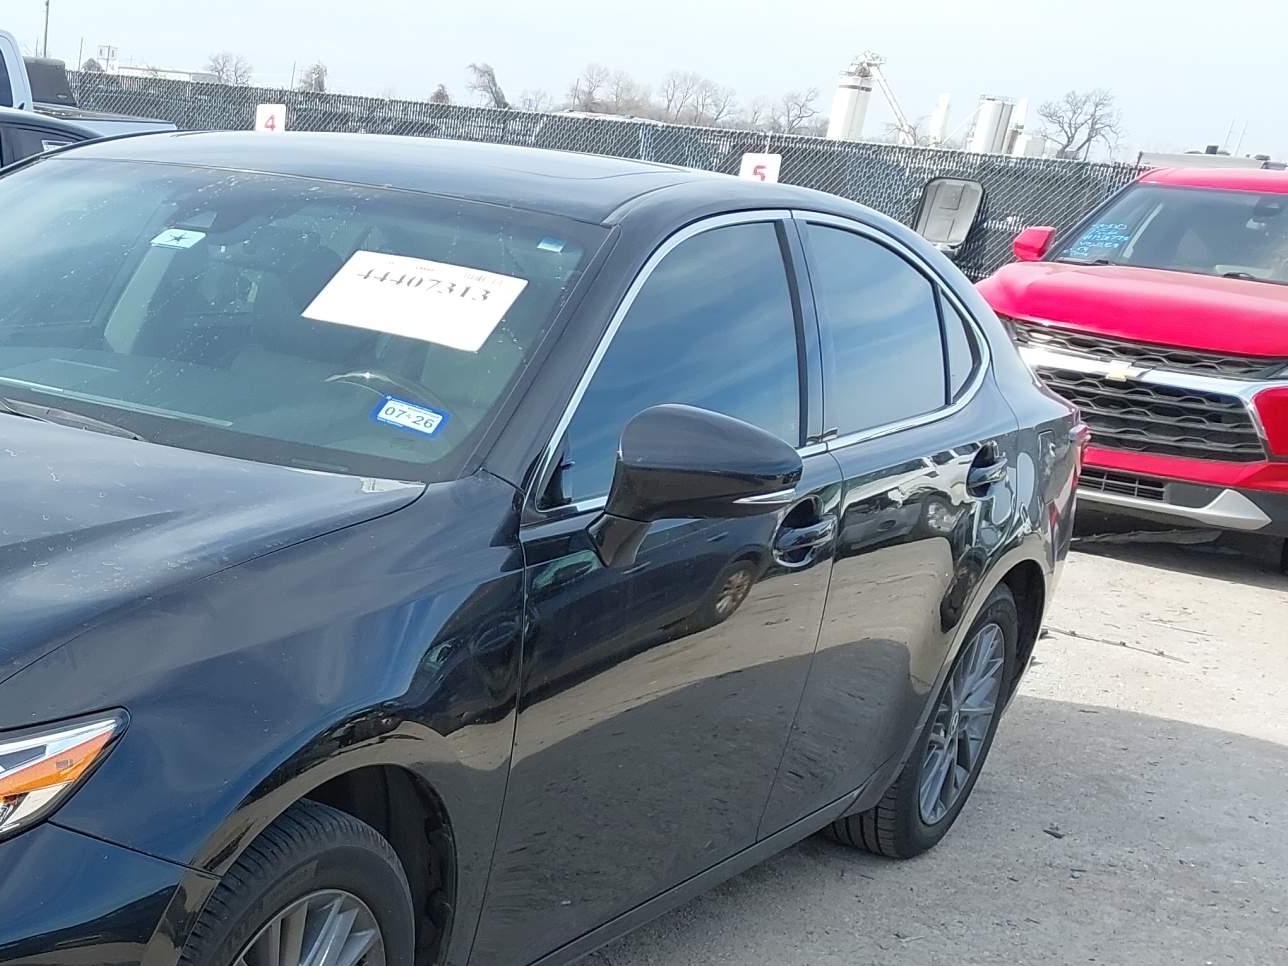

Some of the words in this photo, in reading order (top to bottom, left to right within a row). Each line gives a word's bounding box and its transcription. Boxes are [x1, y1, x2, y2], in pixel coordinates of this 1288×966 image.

[263, 114, 277, 132] 4
[752, 163, 768, 182] 5
[355, 267, 492, 302] 44407313
